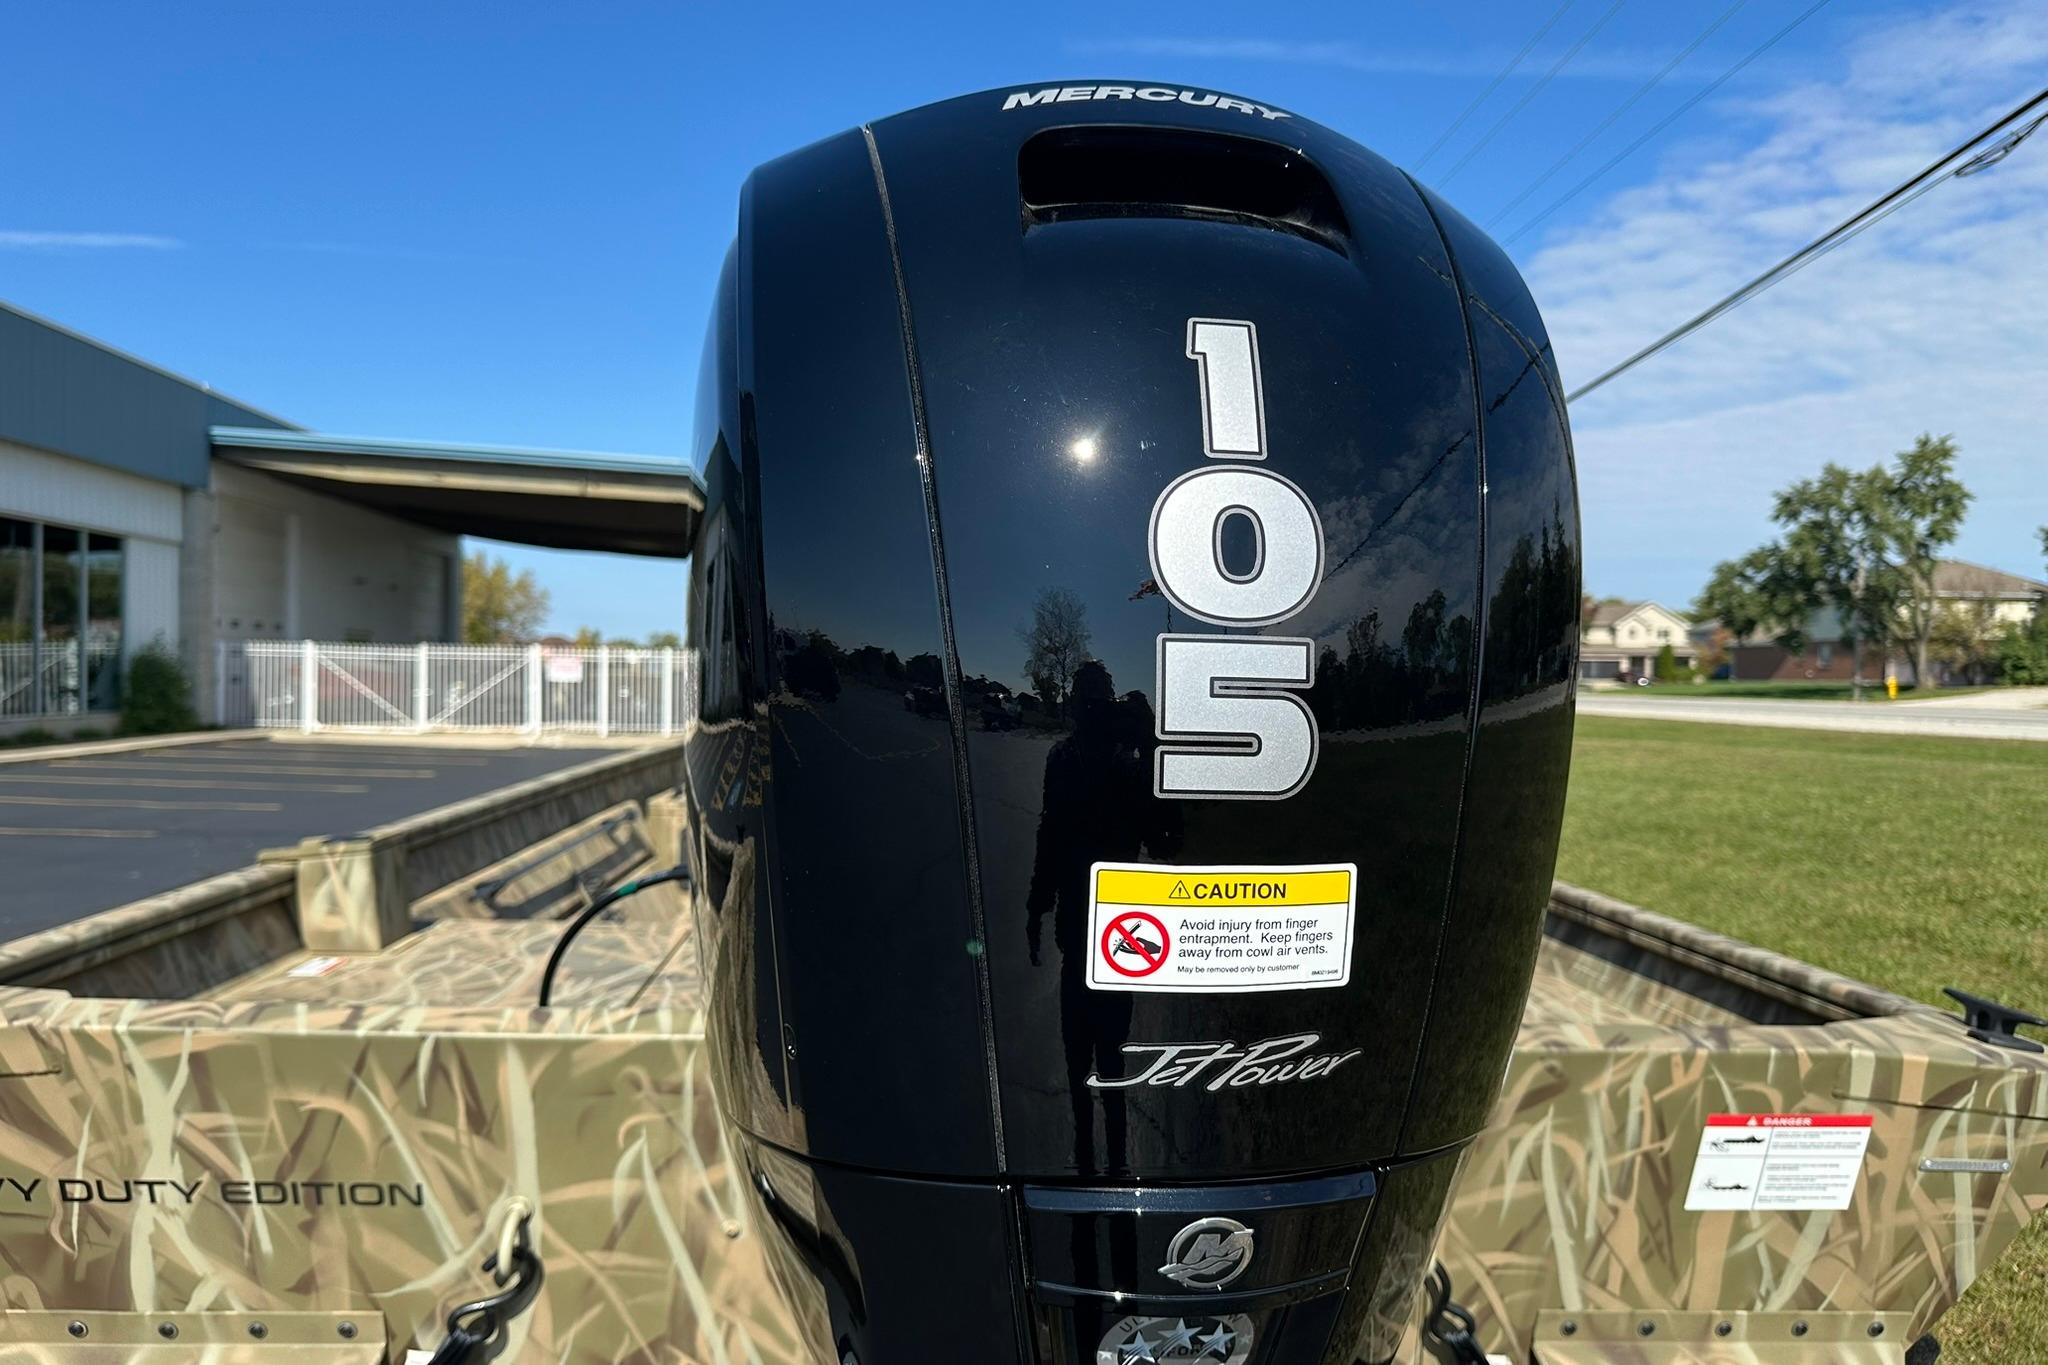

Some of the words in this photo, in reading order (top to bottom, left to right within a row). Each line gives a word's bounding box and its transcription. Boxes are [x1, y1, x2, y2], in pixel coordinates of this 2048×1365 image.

[1001, 86, 1293, 120] MERCURY
[1148, 317, 1326, 801] 105
[1193, 883, 1287, 899] CAUTION
[1180, 919, 1215, 931] Avoid
[1218, 919, 1251, 932] injury
[1255, 918, 1282, 930] from
[1286, 917, 1318, 931] finger
[1179, 933, 1253, 946] entrapment.
[1261, 932, 1292, 946] Keep
[1295, 930, 1333, 943] fingers
[1178, 949, 1212, 960] away
[1215, 947, 1243, 958] from
[1246, 946, 1273, 957] cowl
[1276, 946, 1292, 956] air
[1295, 943, 1328, 955] vents.
[1177, 966, 1194, 974] May
[1240, 966, 1256, 974] only
[1257, 965, 1266, 973] by
[1267, 964, 1300, 972] customer
[1763, 1117, 1813, 1126] DANGER
[58, 1179, 203, 1202] DUTY
[221, 1181, 424, 1206] EDITION
